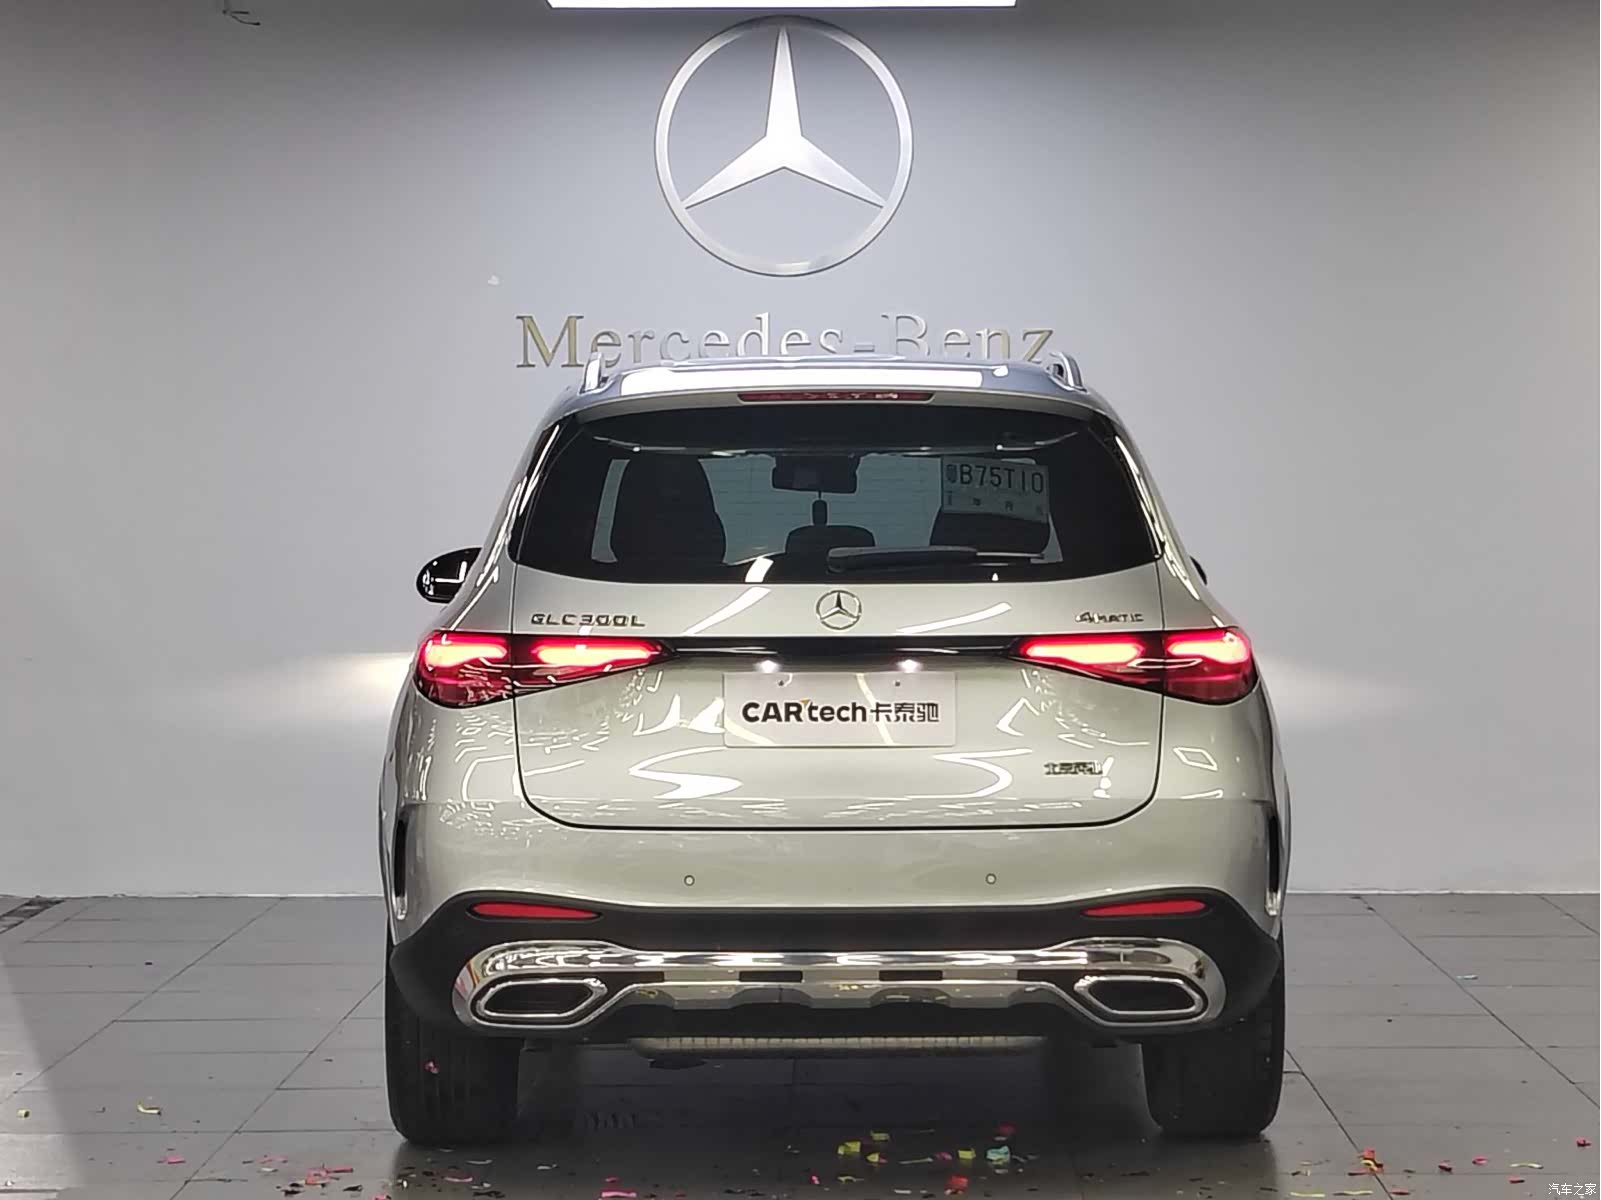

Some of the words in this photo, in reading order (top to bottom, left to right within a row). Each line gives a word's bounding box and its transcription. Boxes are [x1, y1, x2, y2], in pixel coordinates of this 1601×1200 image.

[515, 312, 1055, 369] Mercedes-Benz
[742, 701, 867, 723] CARtech
[870, 702, 939, 723] 卡泰驰
